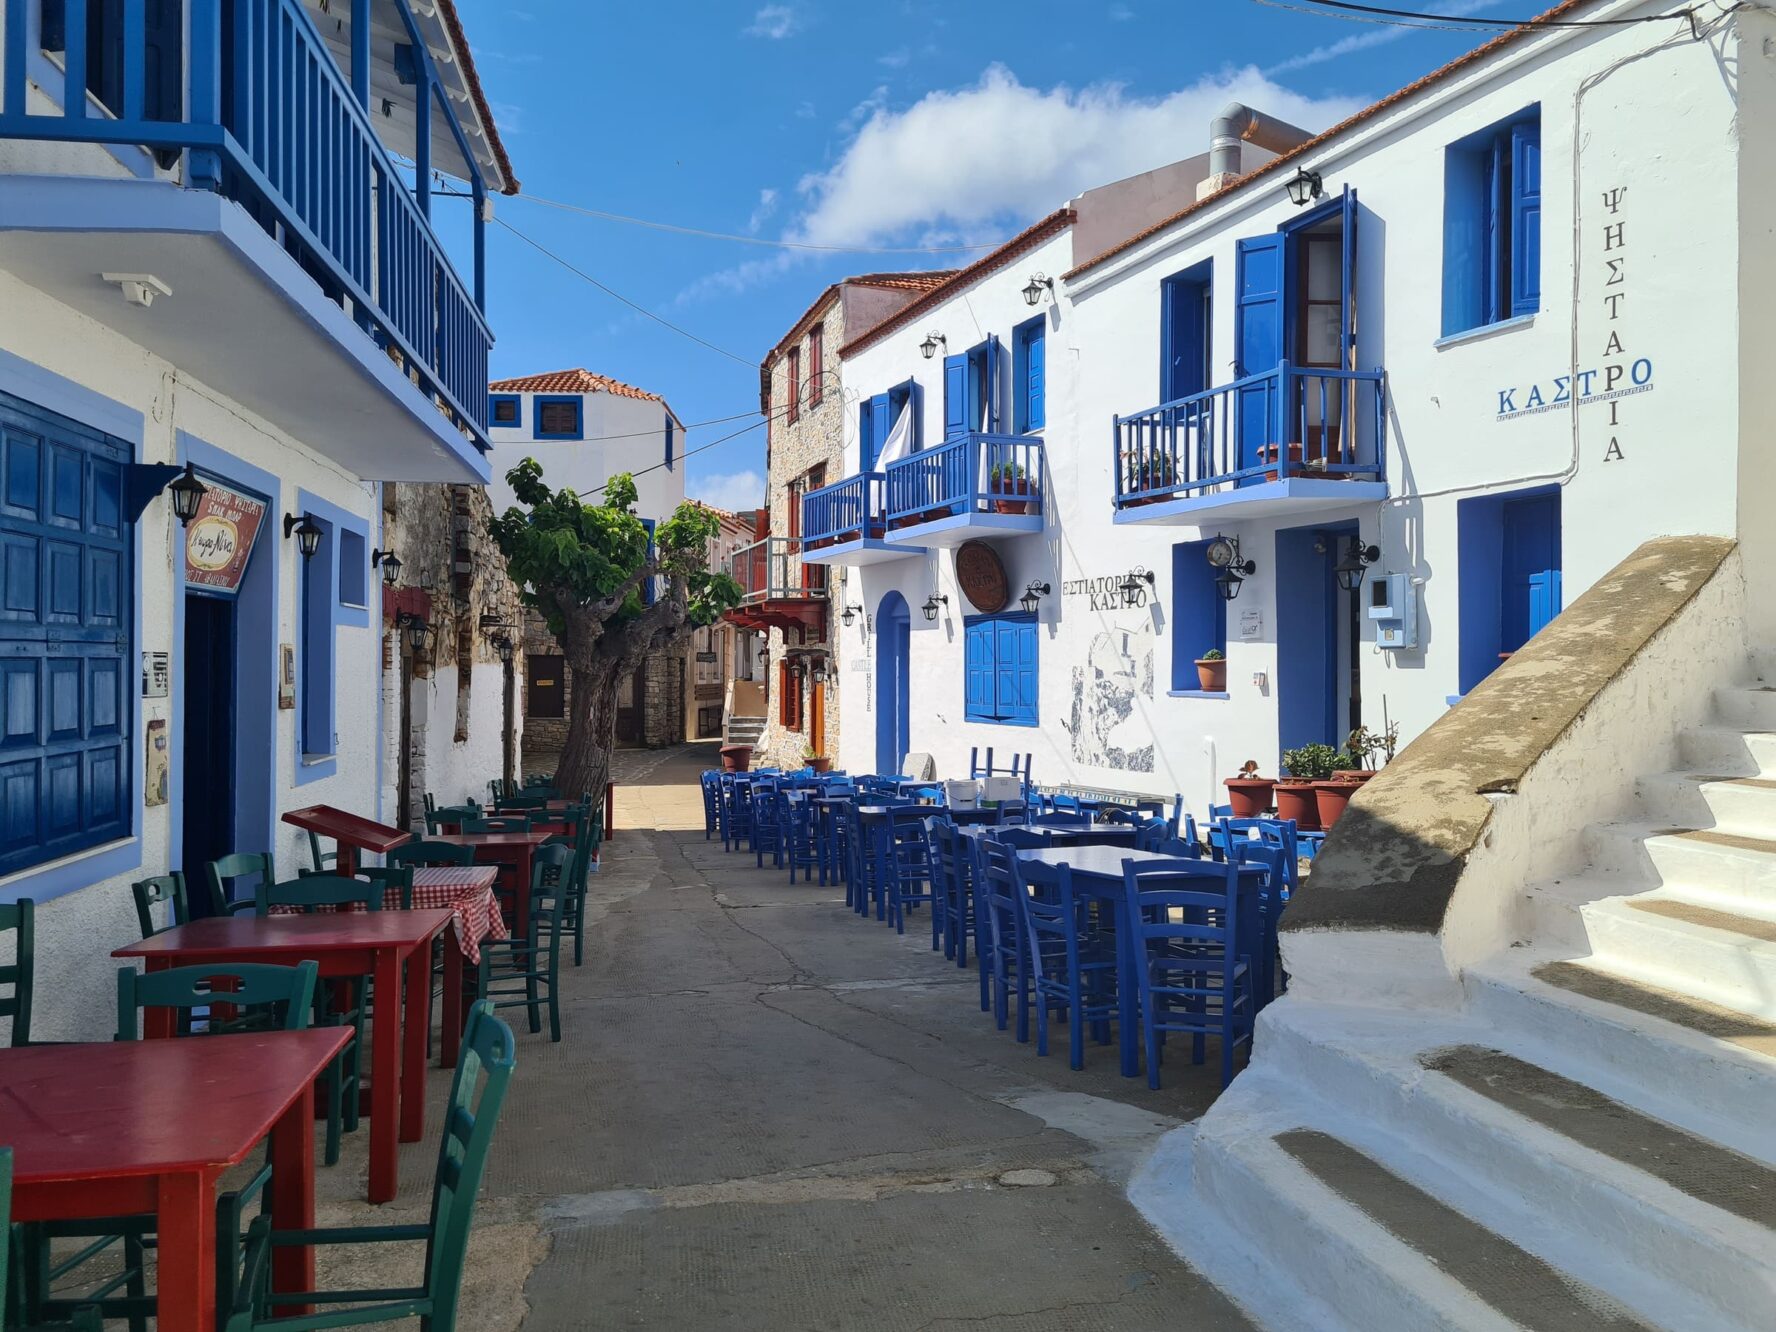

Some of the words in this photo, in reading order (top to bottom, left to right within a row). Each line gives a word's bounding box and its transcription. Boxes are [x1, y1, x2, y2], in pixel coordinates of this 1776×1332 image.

[1602, 186, 1628, 463] ΨΗΣΤΑΡΙΑ
[1497, 358, 1652, 415] ΚΑΣΤΡΟ
[1062, 575, 1128, 595] ΕΣΤΙΑΤΟΡΙ
